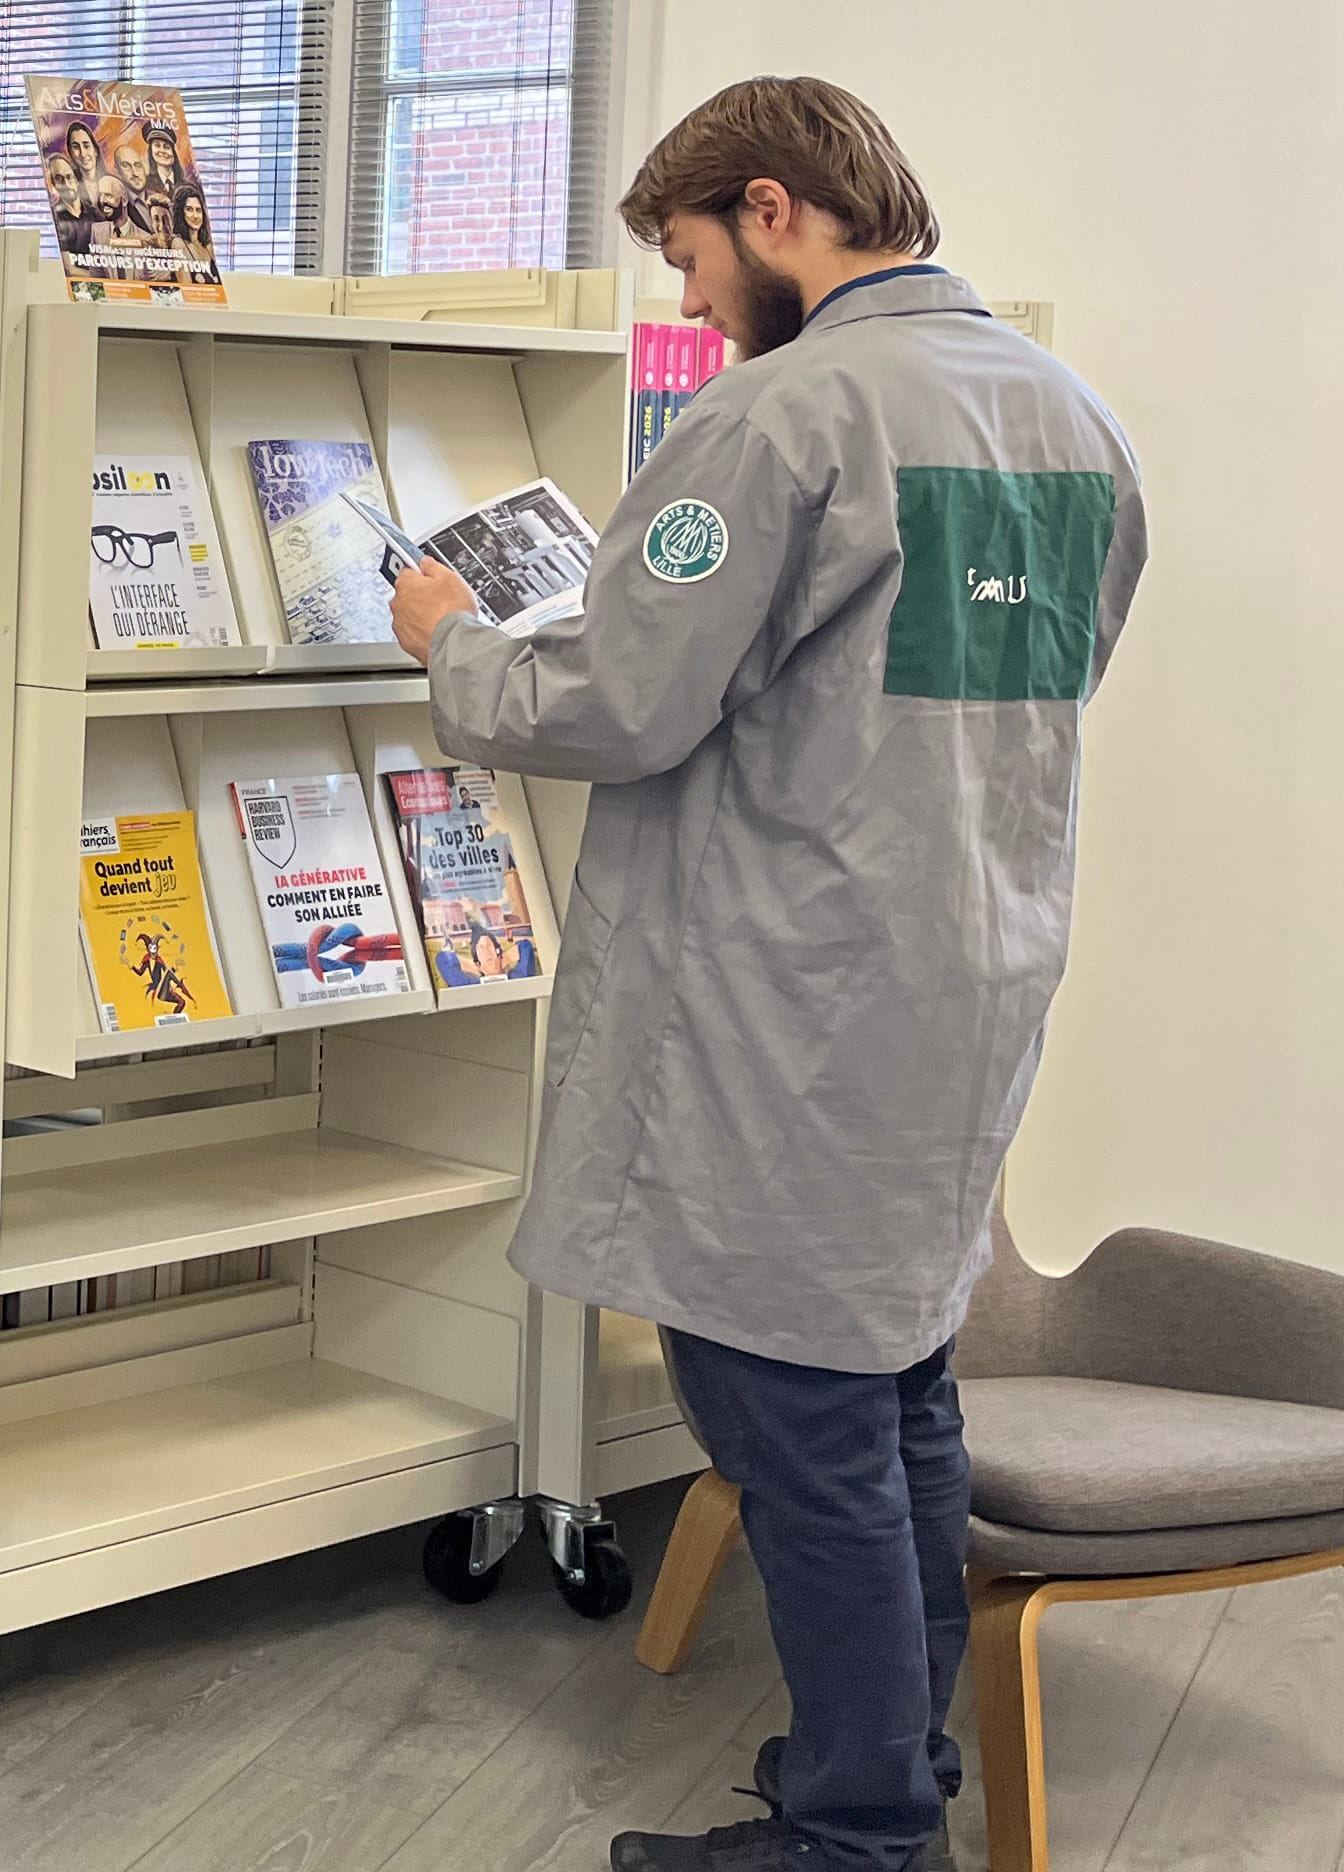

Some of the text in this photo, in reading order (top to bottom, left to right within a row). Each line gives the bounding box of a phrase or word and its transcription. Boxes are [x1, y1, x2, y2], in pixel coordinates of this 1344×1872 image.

[150, 118, 180, 131] MAG
[69, 253, 212, 275] PARCOURS D'EXCEPTION
[664, 406, 672, 431] 026
[643, 405, 652, 460] EIC 2026
[655, 505, 684, 533] ARTS
[653, 555, 682, 578] LILLE
[110, 583, 180, 609] L'INTERFACE
[112, 611, 136, 637] QUI
[80, 823, 109, 837] hiers
[251, 813, 286, 828] BUSINESS
[254, 827, 281, 841] REVIEW
[434, 823, 485, 849] Top 30
[94, 855, 175, 879] Quand tout
[429, 845, 500, 869] des villes
[100, 877, 153, 897] devient
[274, 867, 367, 889] IA GÉNÉRATIVE
[267, 883, 383, 908] COMMENT EN FAIRE
[294, 901, 363, 923] SON ALLIÉE
